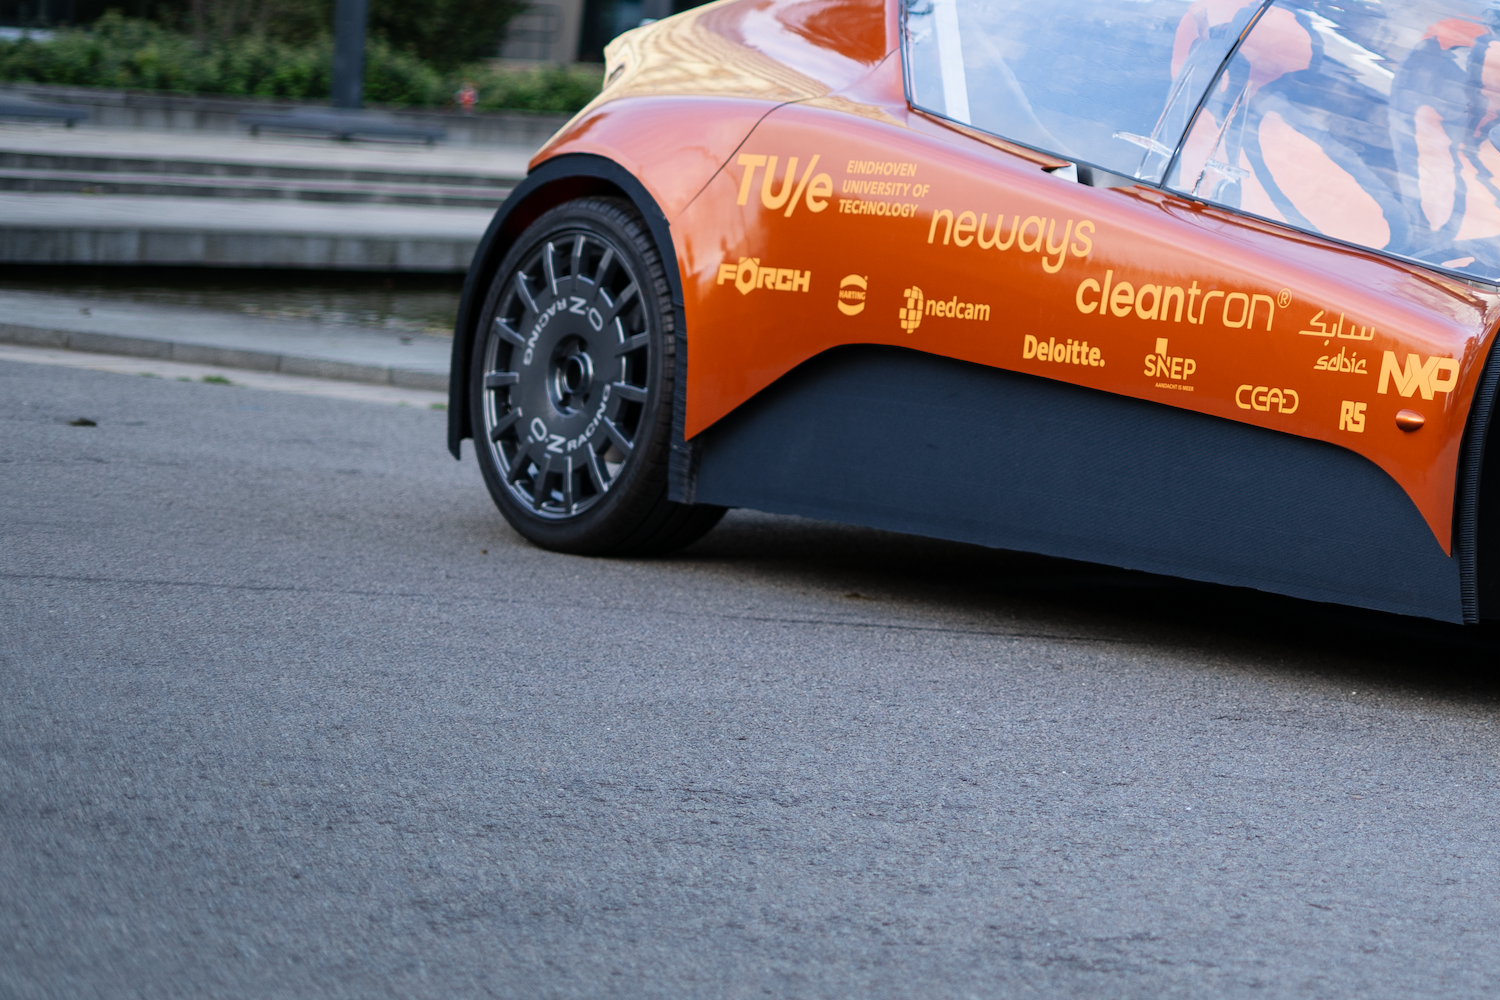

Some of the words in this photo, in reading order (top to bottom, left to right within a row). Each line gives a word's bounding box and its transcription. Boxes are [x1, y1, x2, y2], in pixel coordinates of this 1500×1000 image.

[846, 160, 917, 177] EINDHOVEN
[736, 153, 833, 218] TU/e
[842, 180, 911, 197] UNIVERSITY
[912, 184, 930, 198] OF
[839, 199, 918, 218] TECHNOLOGY
[927, 208, 1096, 274] neways
[838, 290, 866, 300] HARTING
[925, 295, 990, 321] nedcam
[523, 298, 567, 366] RACING
[1143, 345, 1197, 380] SNEP
[1313, 346, 1367, 374] sabic
[1377, 350, 1460, 400] NXP
[1235, 384, 1299, 414] CEAD
[567, 384, 611, 452] RACING
[1339, 400, 1367, 433] RS
